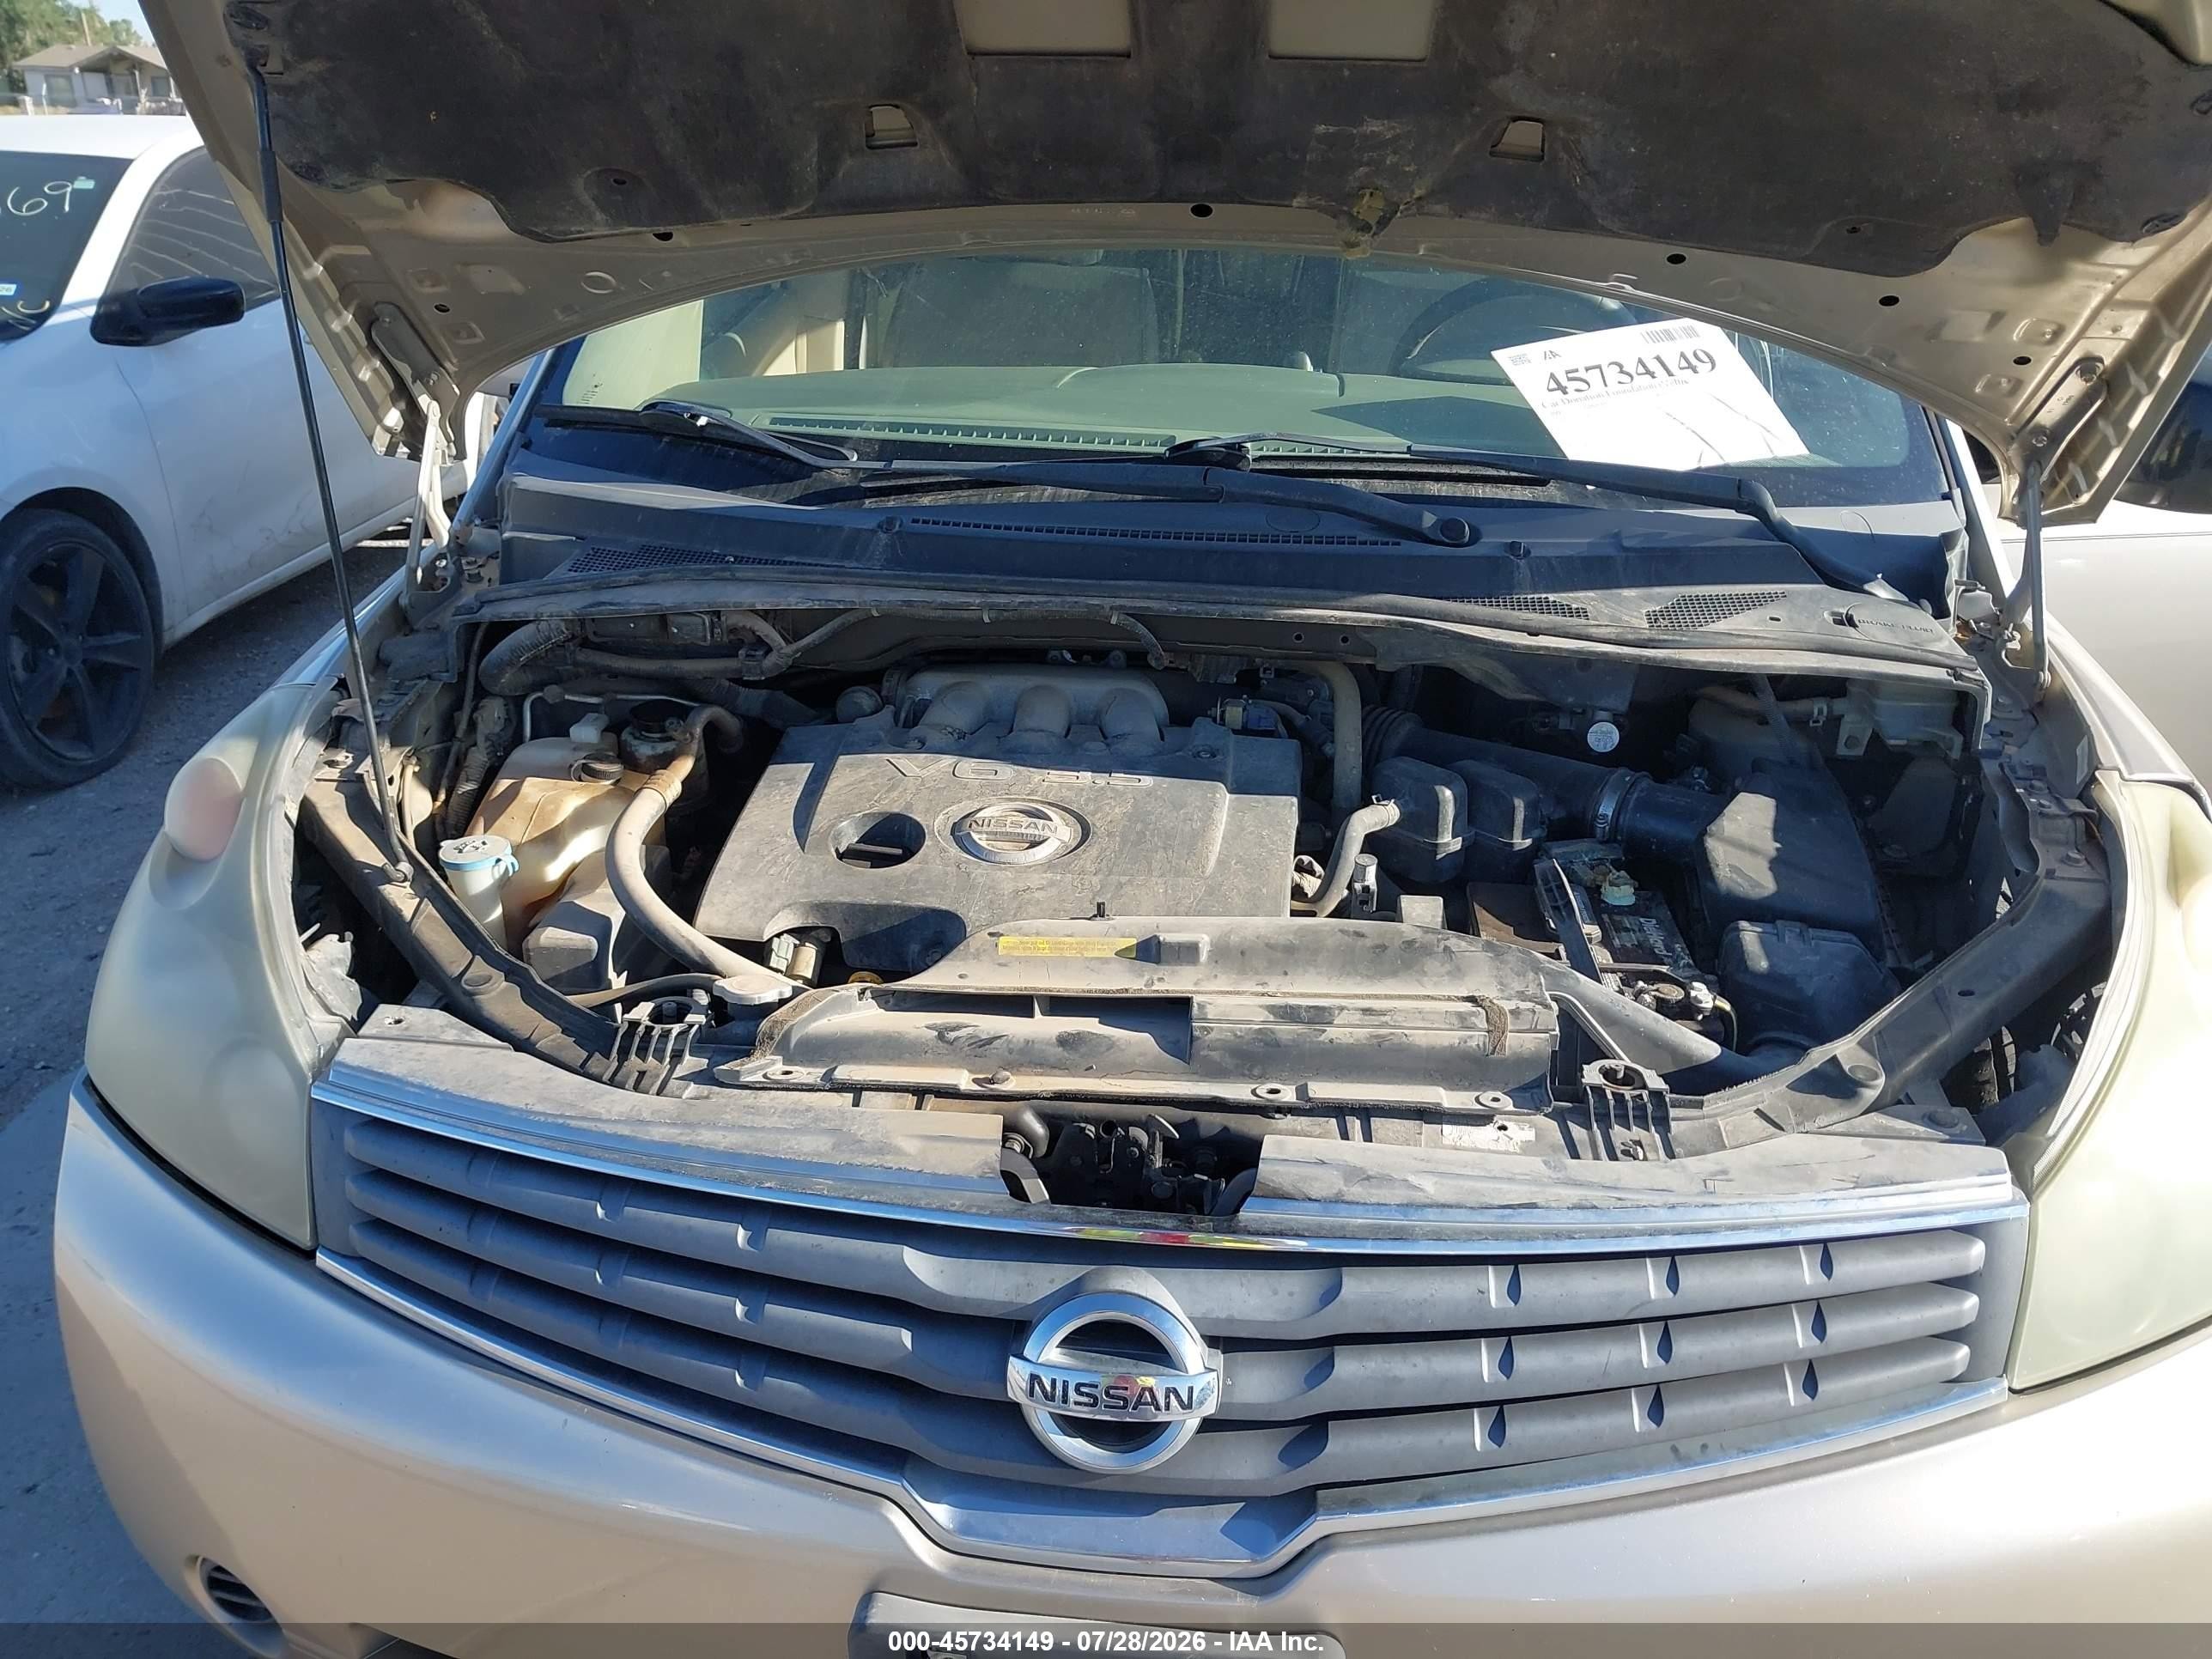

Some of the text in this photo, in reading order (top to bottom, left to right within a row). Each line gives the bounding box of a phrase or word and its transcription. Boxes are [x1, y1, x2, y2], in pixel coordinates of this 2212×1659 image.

[0, 180, 73, 216] 69
[1547, 349, 1717, 395] 45734149
[885, 757, 1153, 787] V6 3.5
[968, 818, 1058, 836] NISSAN
[1028, 1373, 1194, 1413] NISSAN
